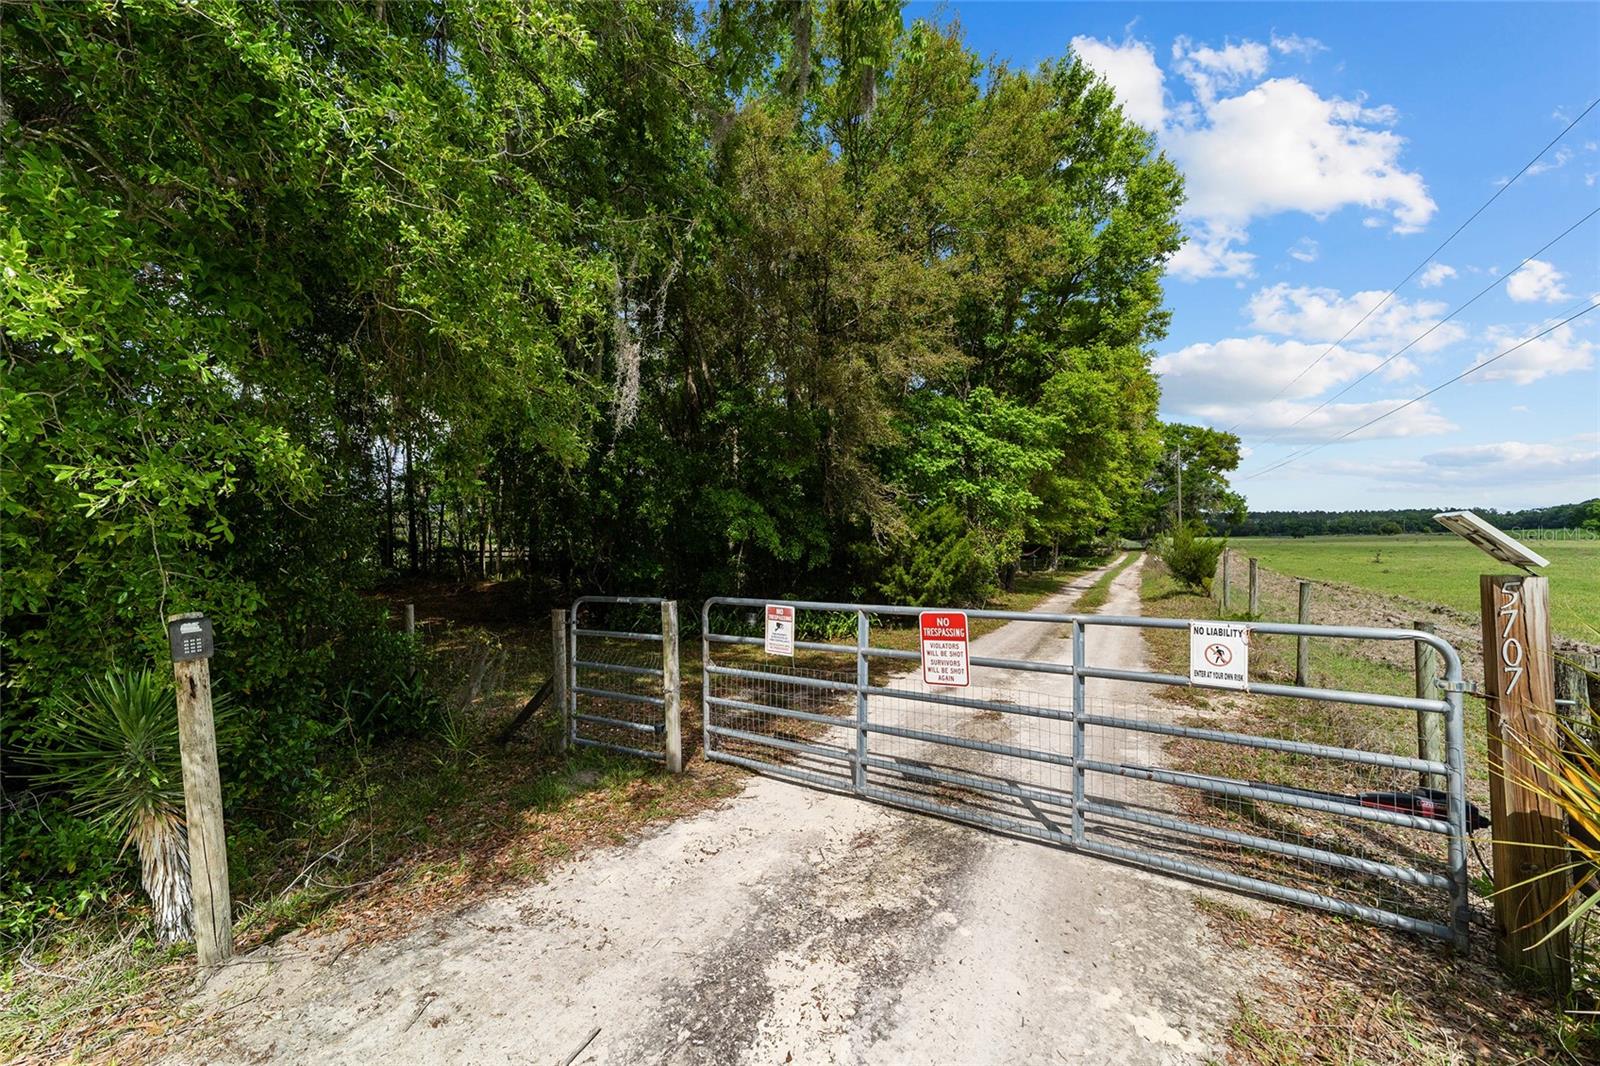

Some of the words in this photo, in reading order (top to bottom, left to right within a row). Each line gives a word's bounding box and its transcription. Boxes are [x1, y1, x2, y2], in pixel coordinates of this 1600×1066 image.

[936, 617, 950, 627] NO
[923, 627, 965, 638] TRESPASSING
[1193, 626, 1205, 635] NO
[1206, 627, 1243, 638] LIABILITY
[1500, 581, 1524, 695] 5707
[929, 642, 960, 650] VIOLATORS
[930, 659, 961, 667] SURVIVORS
[937, 674, 955, 682] AGAIN
[1193, 669, 1206, 678] ENTER
[1213, 672, 1224, 680] YOUR
[1224, 672, 1234, 681] OWN
[1234, 673, 1244, 682] RISK
